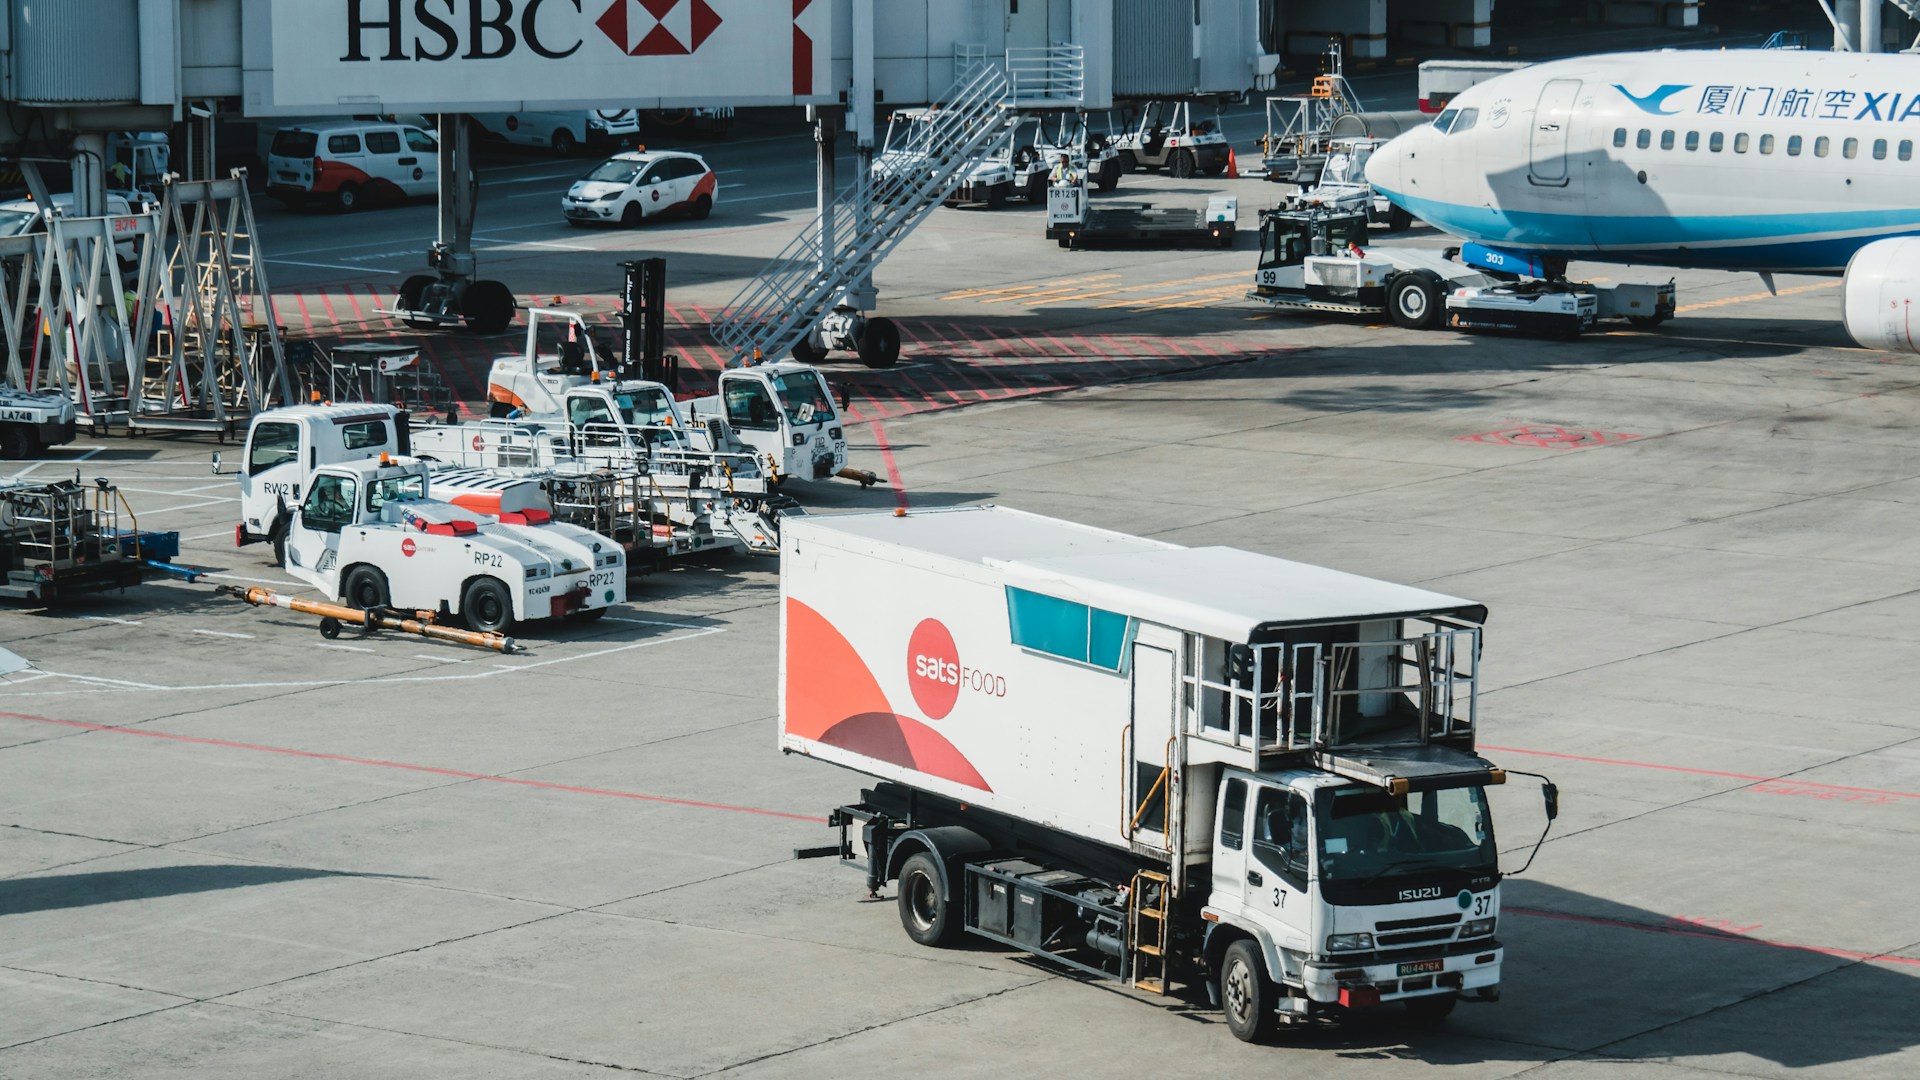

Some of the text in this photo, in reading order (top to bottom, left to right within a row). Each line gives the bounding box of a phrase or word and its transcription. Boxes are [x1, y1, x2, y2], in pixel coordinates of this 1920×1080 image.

[340, 0, 583, 62] HSBC
[1697, 85, 1856, 120] 厦门航空
[1049, 189, 1076, 199] TR129
[1486, 252, 1504, 265] 303
[1262, 270, 1276, 284] 99
[835, 441, 845, 453] RP
[835, 454, 843, 465] 23
[264, 482, 289, 495] RW2
[474, 551, 503, 568] RP22
[589, 571, 615, 588] RP22
[915, 654, 1006, 697] sats FOOD
[1744, 783, 1900, 805] SAFETY
[1273, 881, 1287, 908] 37
[1399, 886, 1441, 900] ISUZU
[1474, 895, 1491, 916] 37
